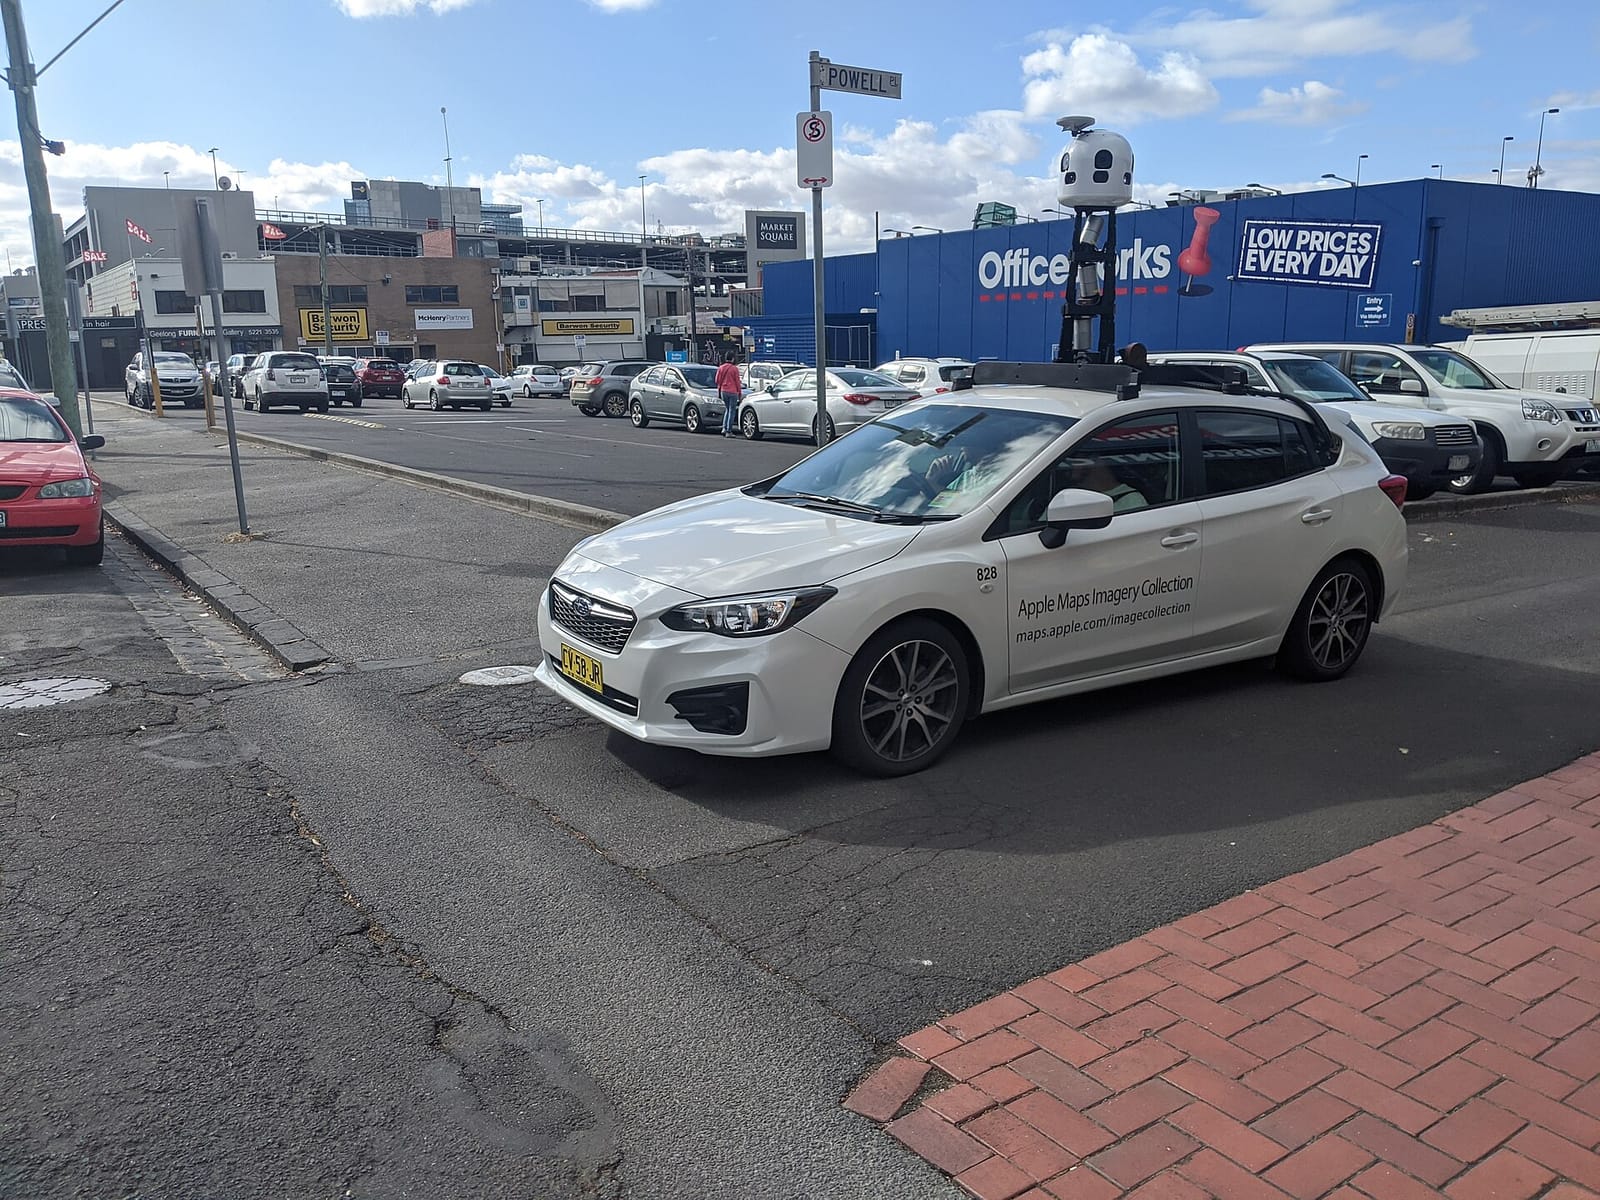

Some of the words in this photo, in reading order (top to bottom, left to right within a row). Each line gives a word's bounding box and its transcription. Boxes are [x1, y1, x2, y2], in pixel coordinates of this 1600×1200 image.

[828, 67, 887, 93] POWELL
[889, 76, 899, 88] PL
[760, 222, 793, 231] MARKET
[760, 231, 794, 243] SQUARE
[1248, 228, 1294, 250] LOW
[1296, 230, 1372, 254] PRICES
[83, 251, 107, 262] SALE
[978, 238, 1171, 289] Officerks
[1245, 248, 1317, 275] EVERY
[1319, 252, 1369, 278] DAY
[1366, 297, 1383, 305] Entry
[86, 320, 93, 328] in
[95, 319, 110, 328] hair
[311, 314, 357, 323] Bawon
[590, 322, 620, 330] Security
[149, 330, 177, 338] Geelong
[976, 566, 998, 582] 828
[1018, 595, 1055, 621] Apple
[1057, 591, 1090, 612] Maps
[1092, 584, 1141, 606] Imagery
[1141, 576, 1193, 597] Collection
[1016, 602, 1191, 643] maps.apple.com/imagecollection
